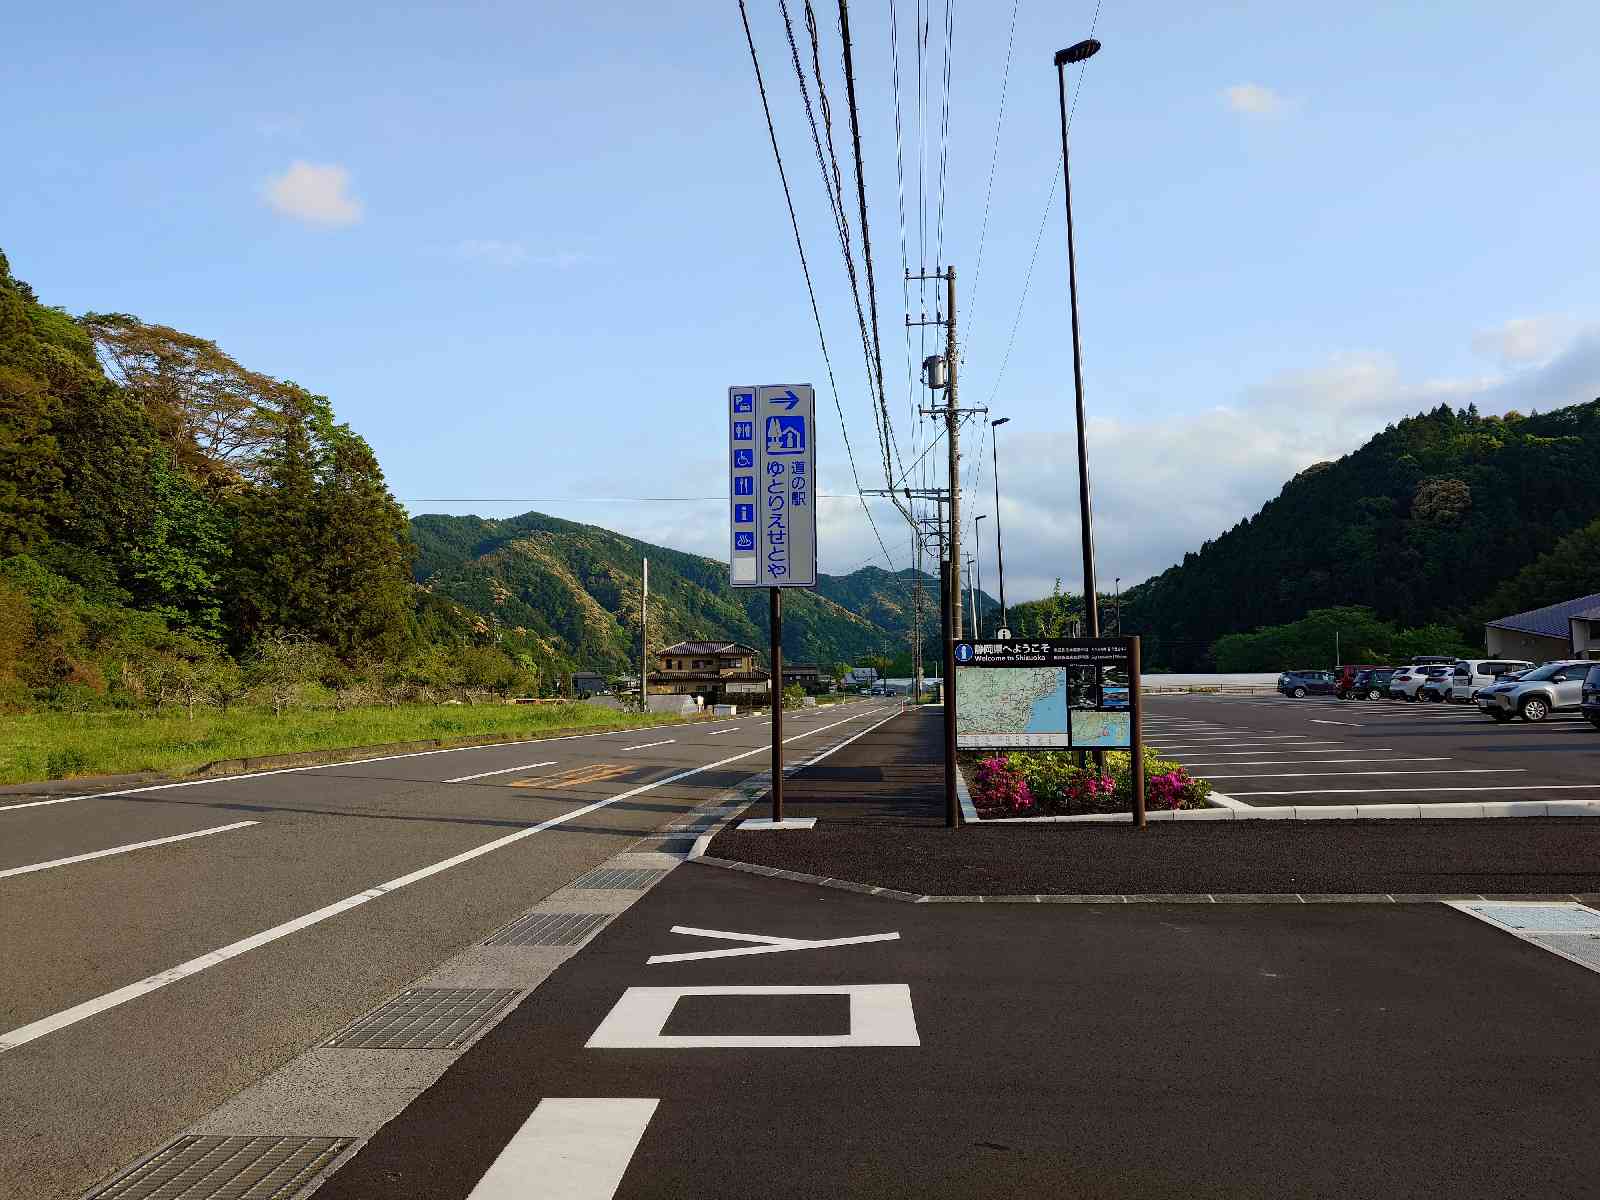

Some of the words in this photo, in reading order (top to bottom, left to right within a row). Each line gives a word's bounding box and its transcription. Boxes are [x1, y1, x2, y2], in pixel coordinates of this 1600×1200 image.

[792, 460, 808, 506] 道の駅
[767, 460, 786, 579] ゆとりえせとや
[974, 643, 1051, 655] 静岡県へようこそ
[974, 654, 1006, 662] Welcome
